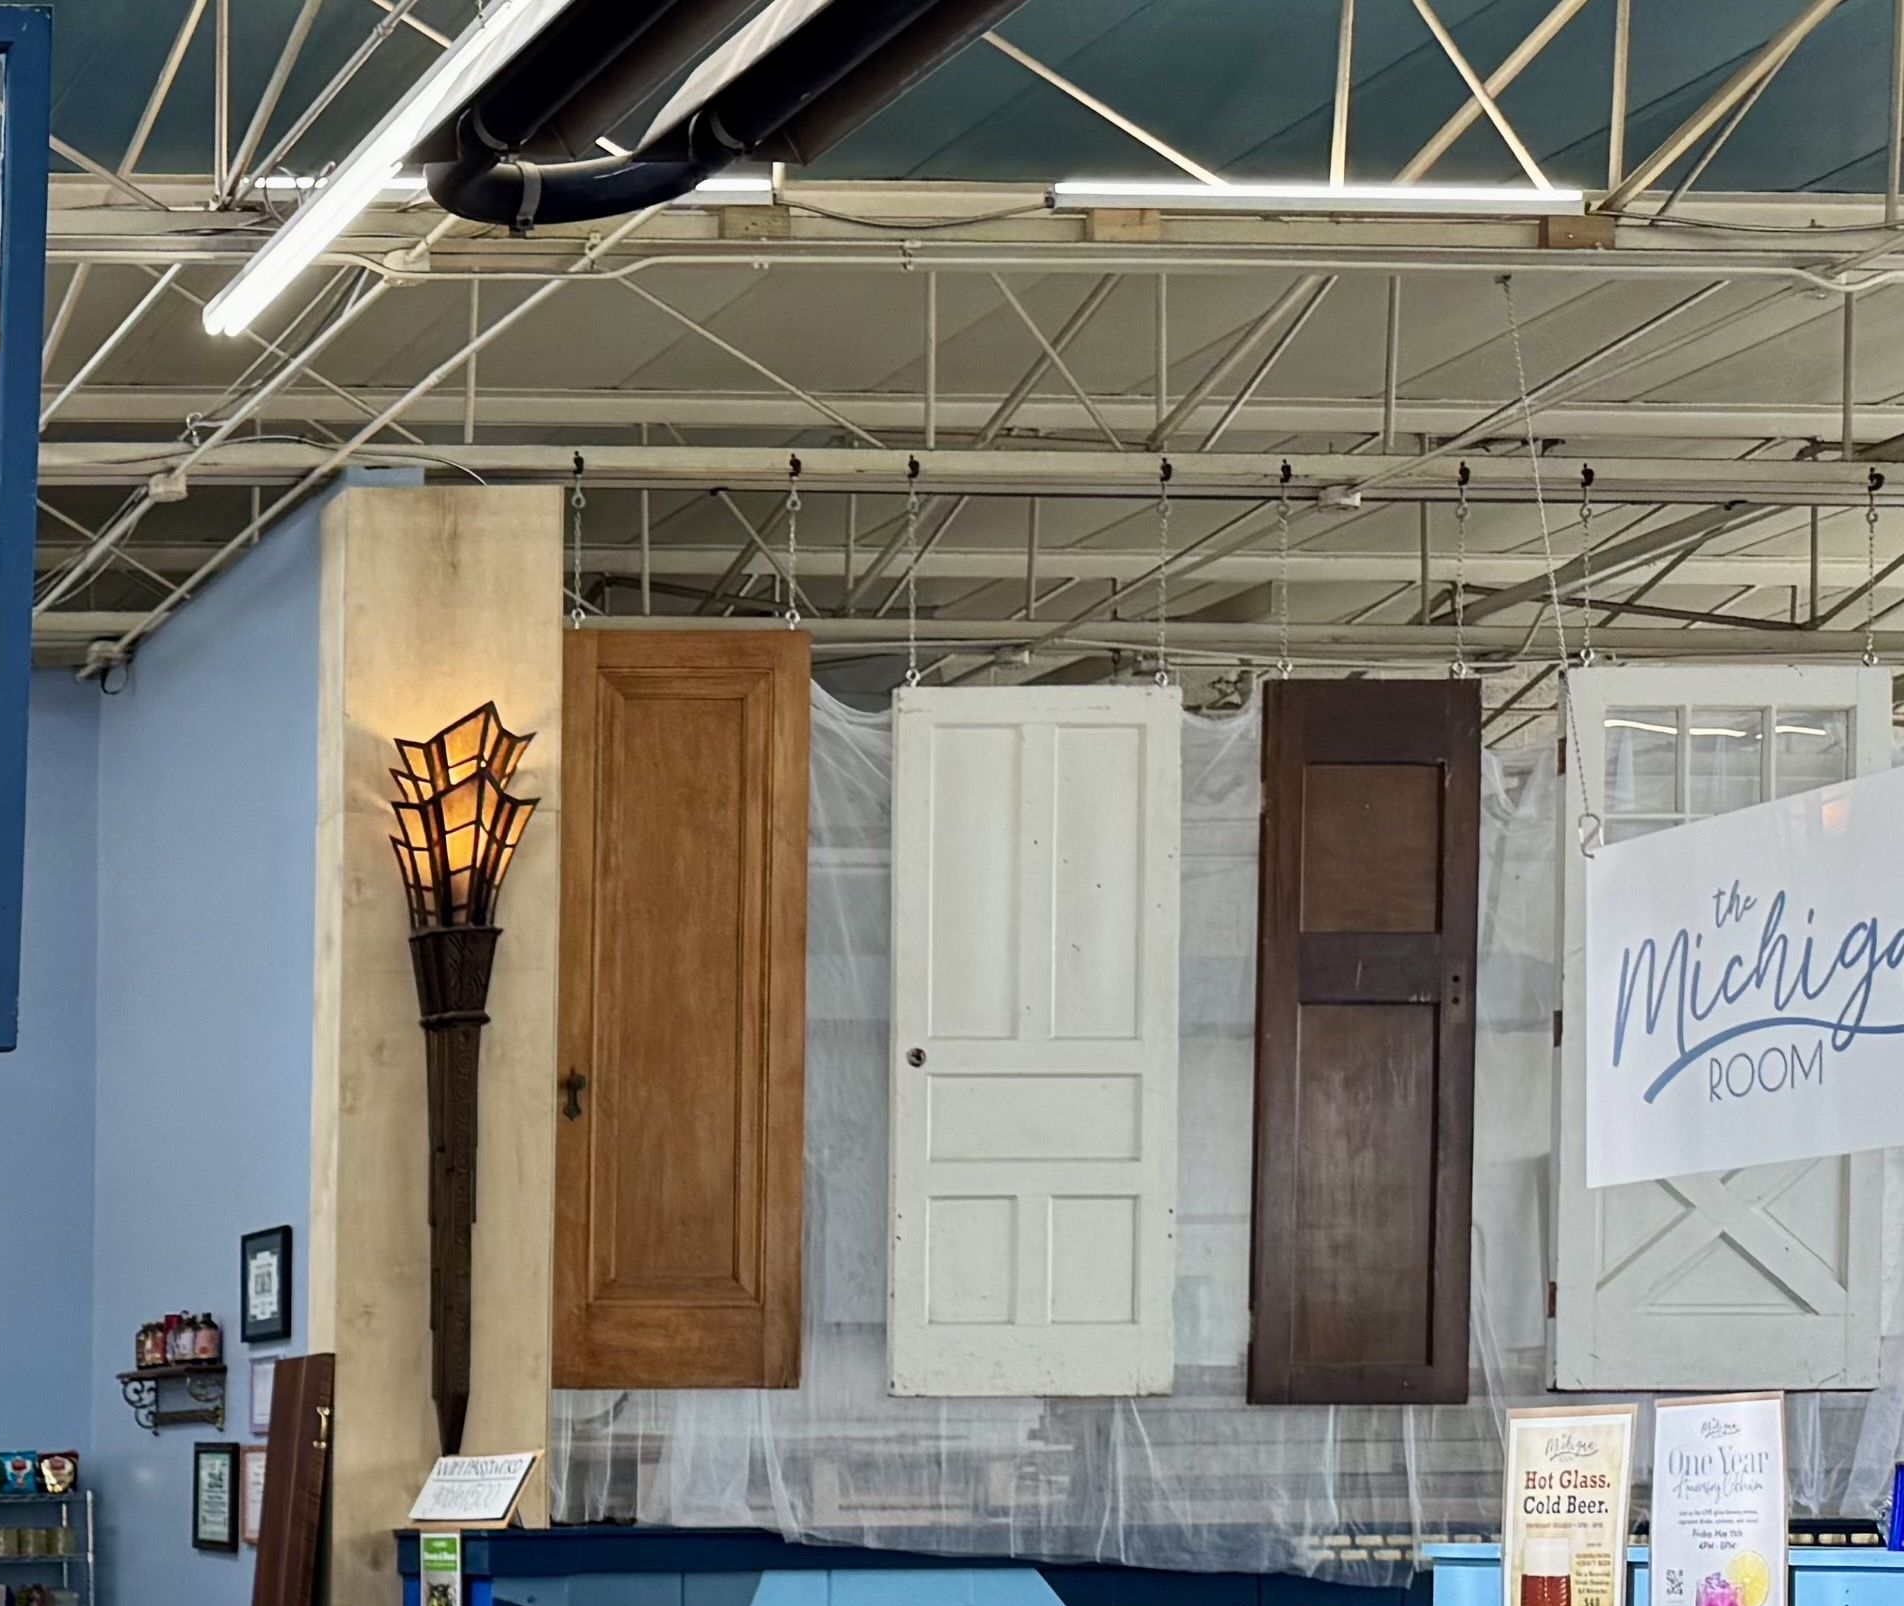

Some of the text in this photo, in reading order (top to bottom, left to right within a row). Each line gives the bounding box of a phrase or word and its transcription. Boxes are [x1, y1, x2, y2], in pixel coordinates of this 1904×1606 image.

[1713, 880, 1758, 928] the
[1709, 1039, 1823, 1102] ROOM
[1669, 1446, 1768, 1476] One Year
[1525, 1470, 1610, 1489] Hot Glass.
[1523, 1495, 1608, 1514] Cold Beer.
